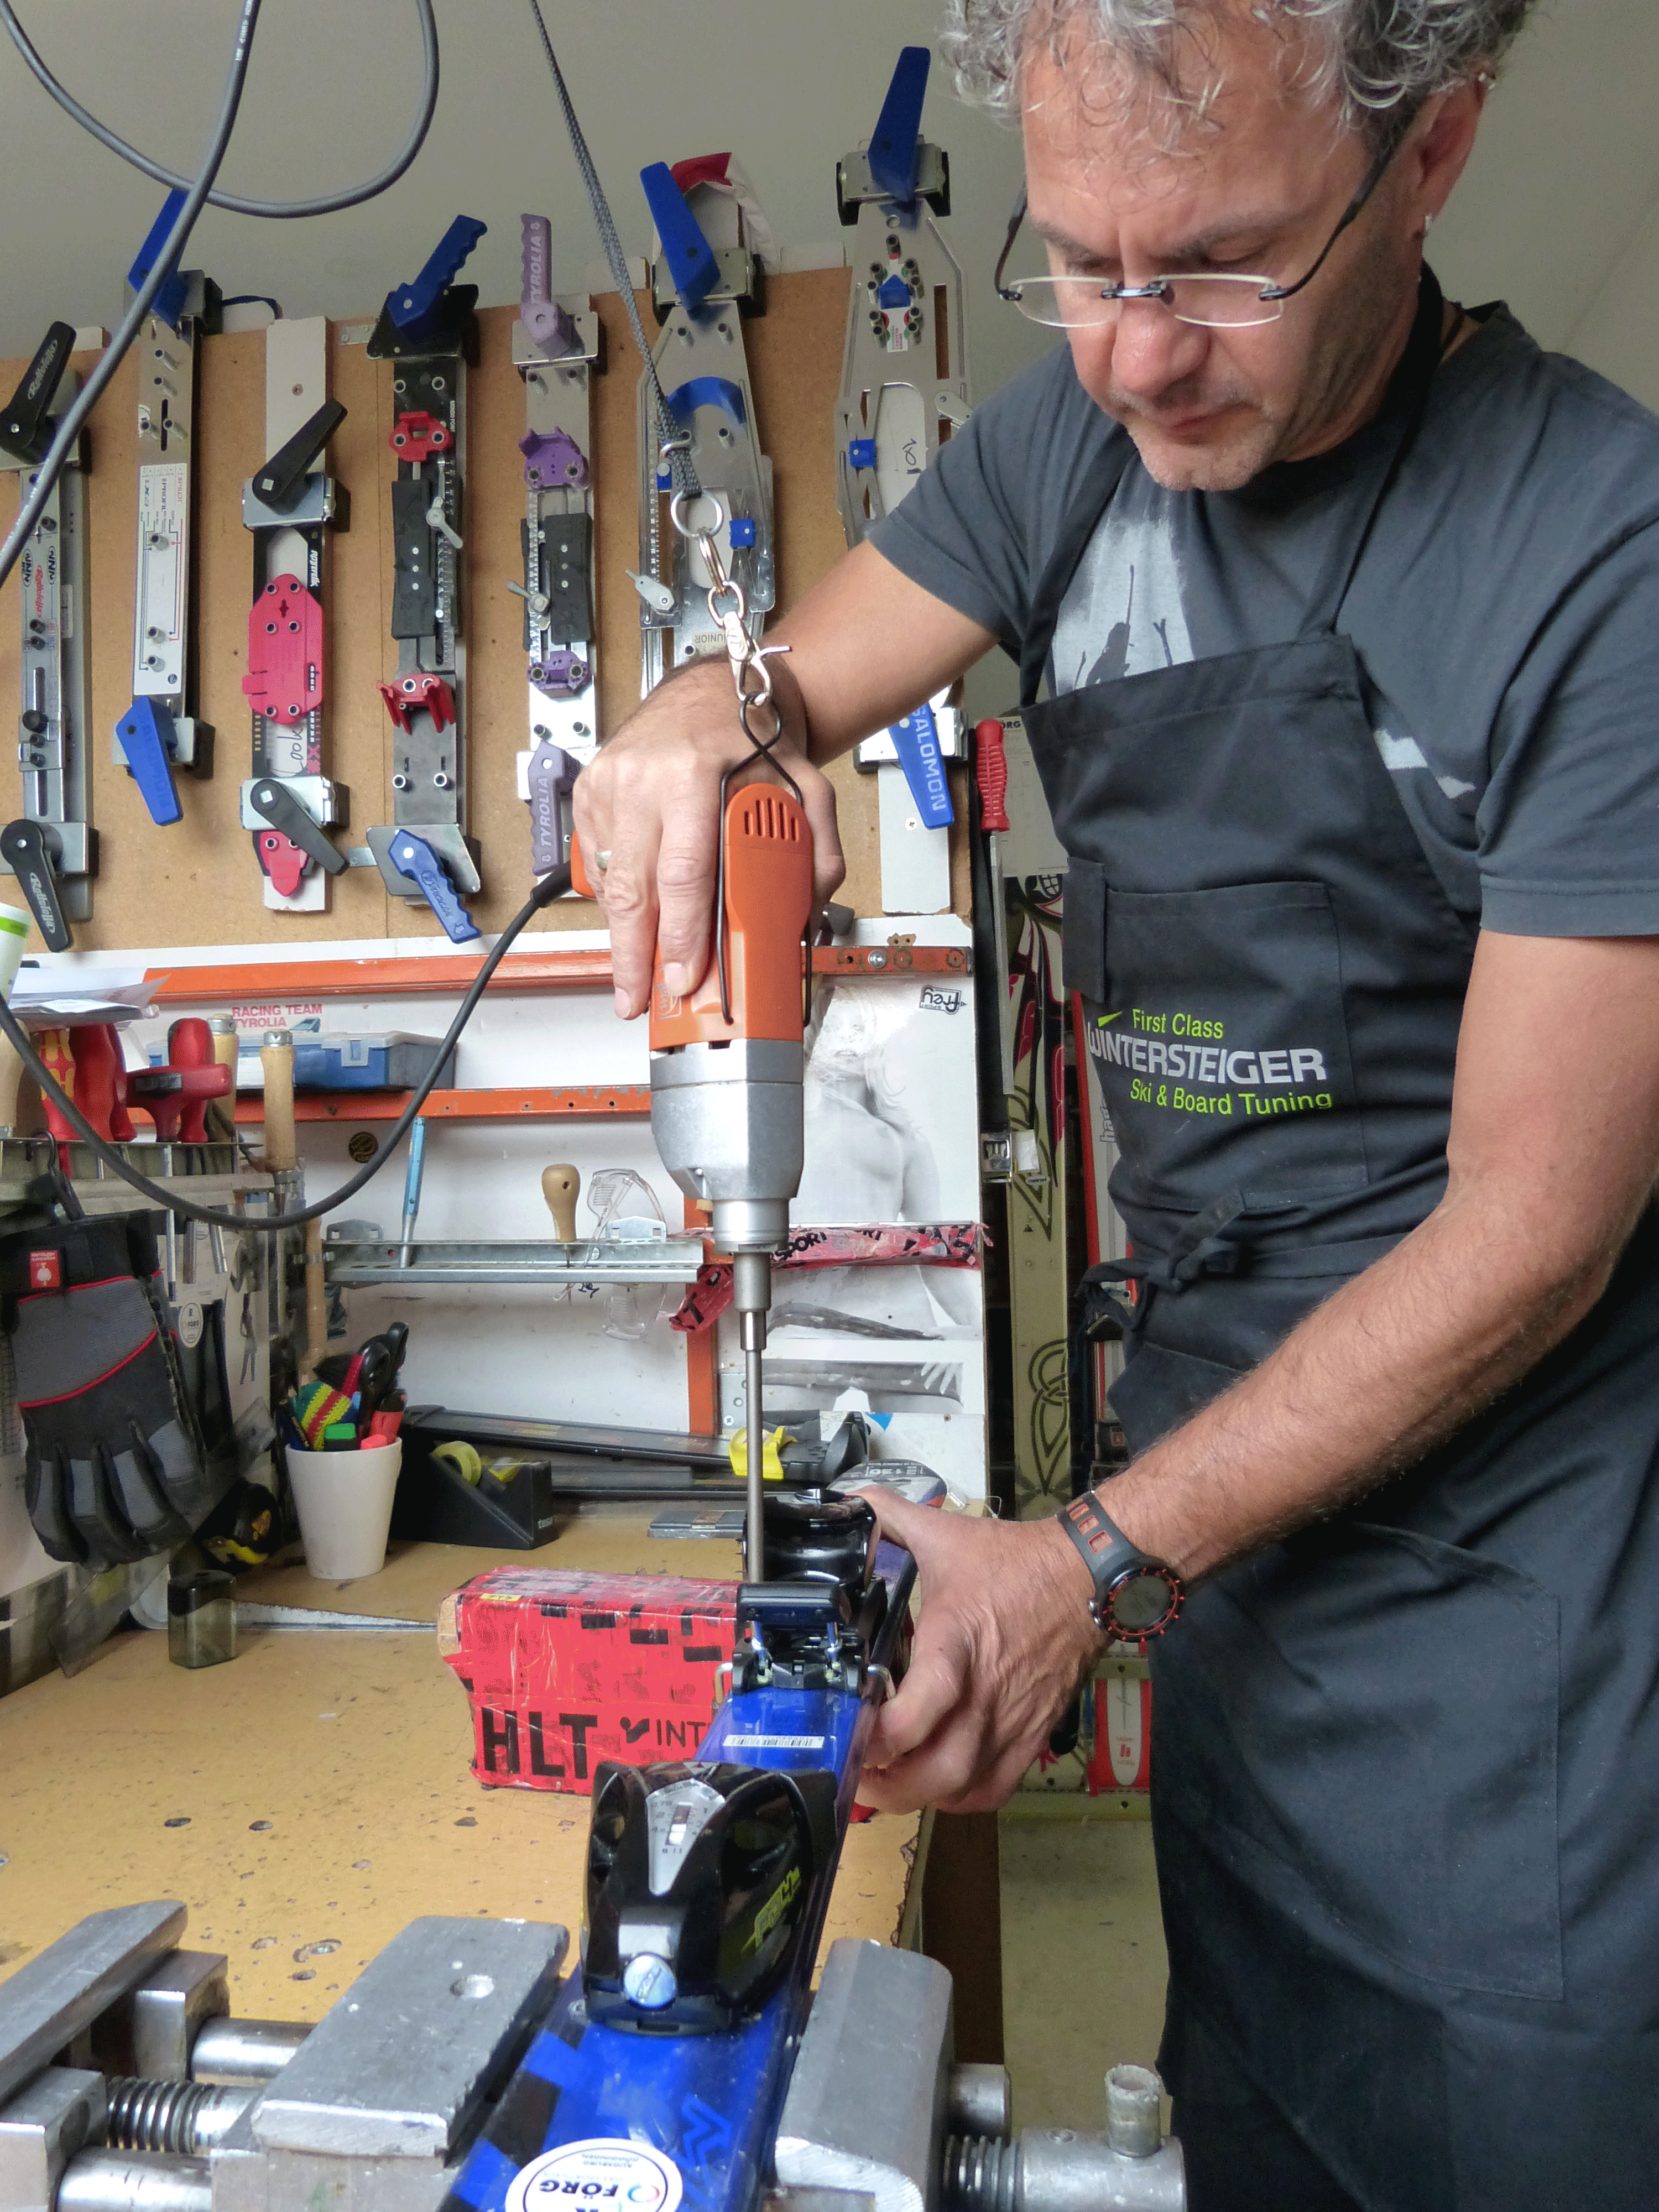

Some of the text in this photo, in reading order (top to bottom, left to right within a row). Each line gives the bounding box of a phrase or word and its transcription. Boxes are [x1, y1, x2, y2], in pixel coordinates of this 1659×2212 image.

[530, 235, 542, 305] TYROLIA
[539, 776, 555, 848] TYROLIA
[232, 1004, 322, 1017] RACING TEAM
[233, 1016, 287, 1029] TYROLIA
[1133, 1008, 1224, 1039] First Class
[1086, 1021, 1327, 1084] WINTERSTEIGER
[1130, 1078, 1332, 1116] Ski & Board Tuning
[481, 1705, 599, 1780] HLT
[539, 2179, 619, 2200] FÖRG
